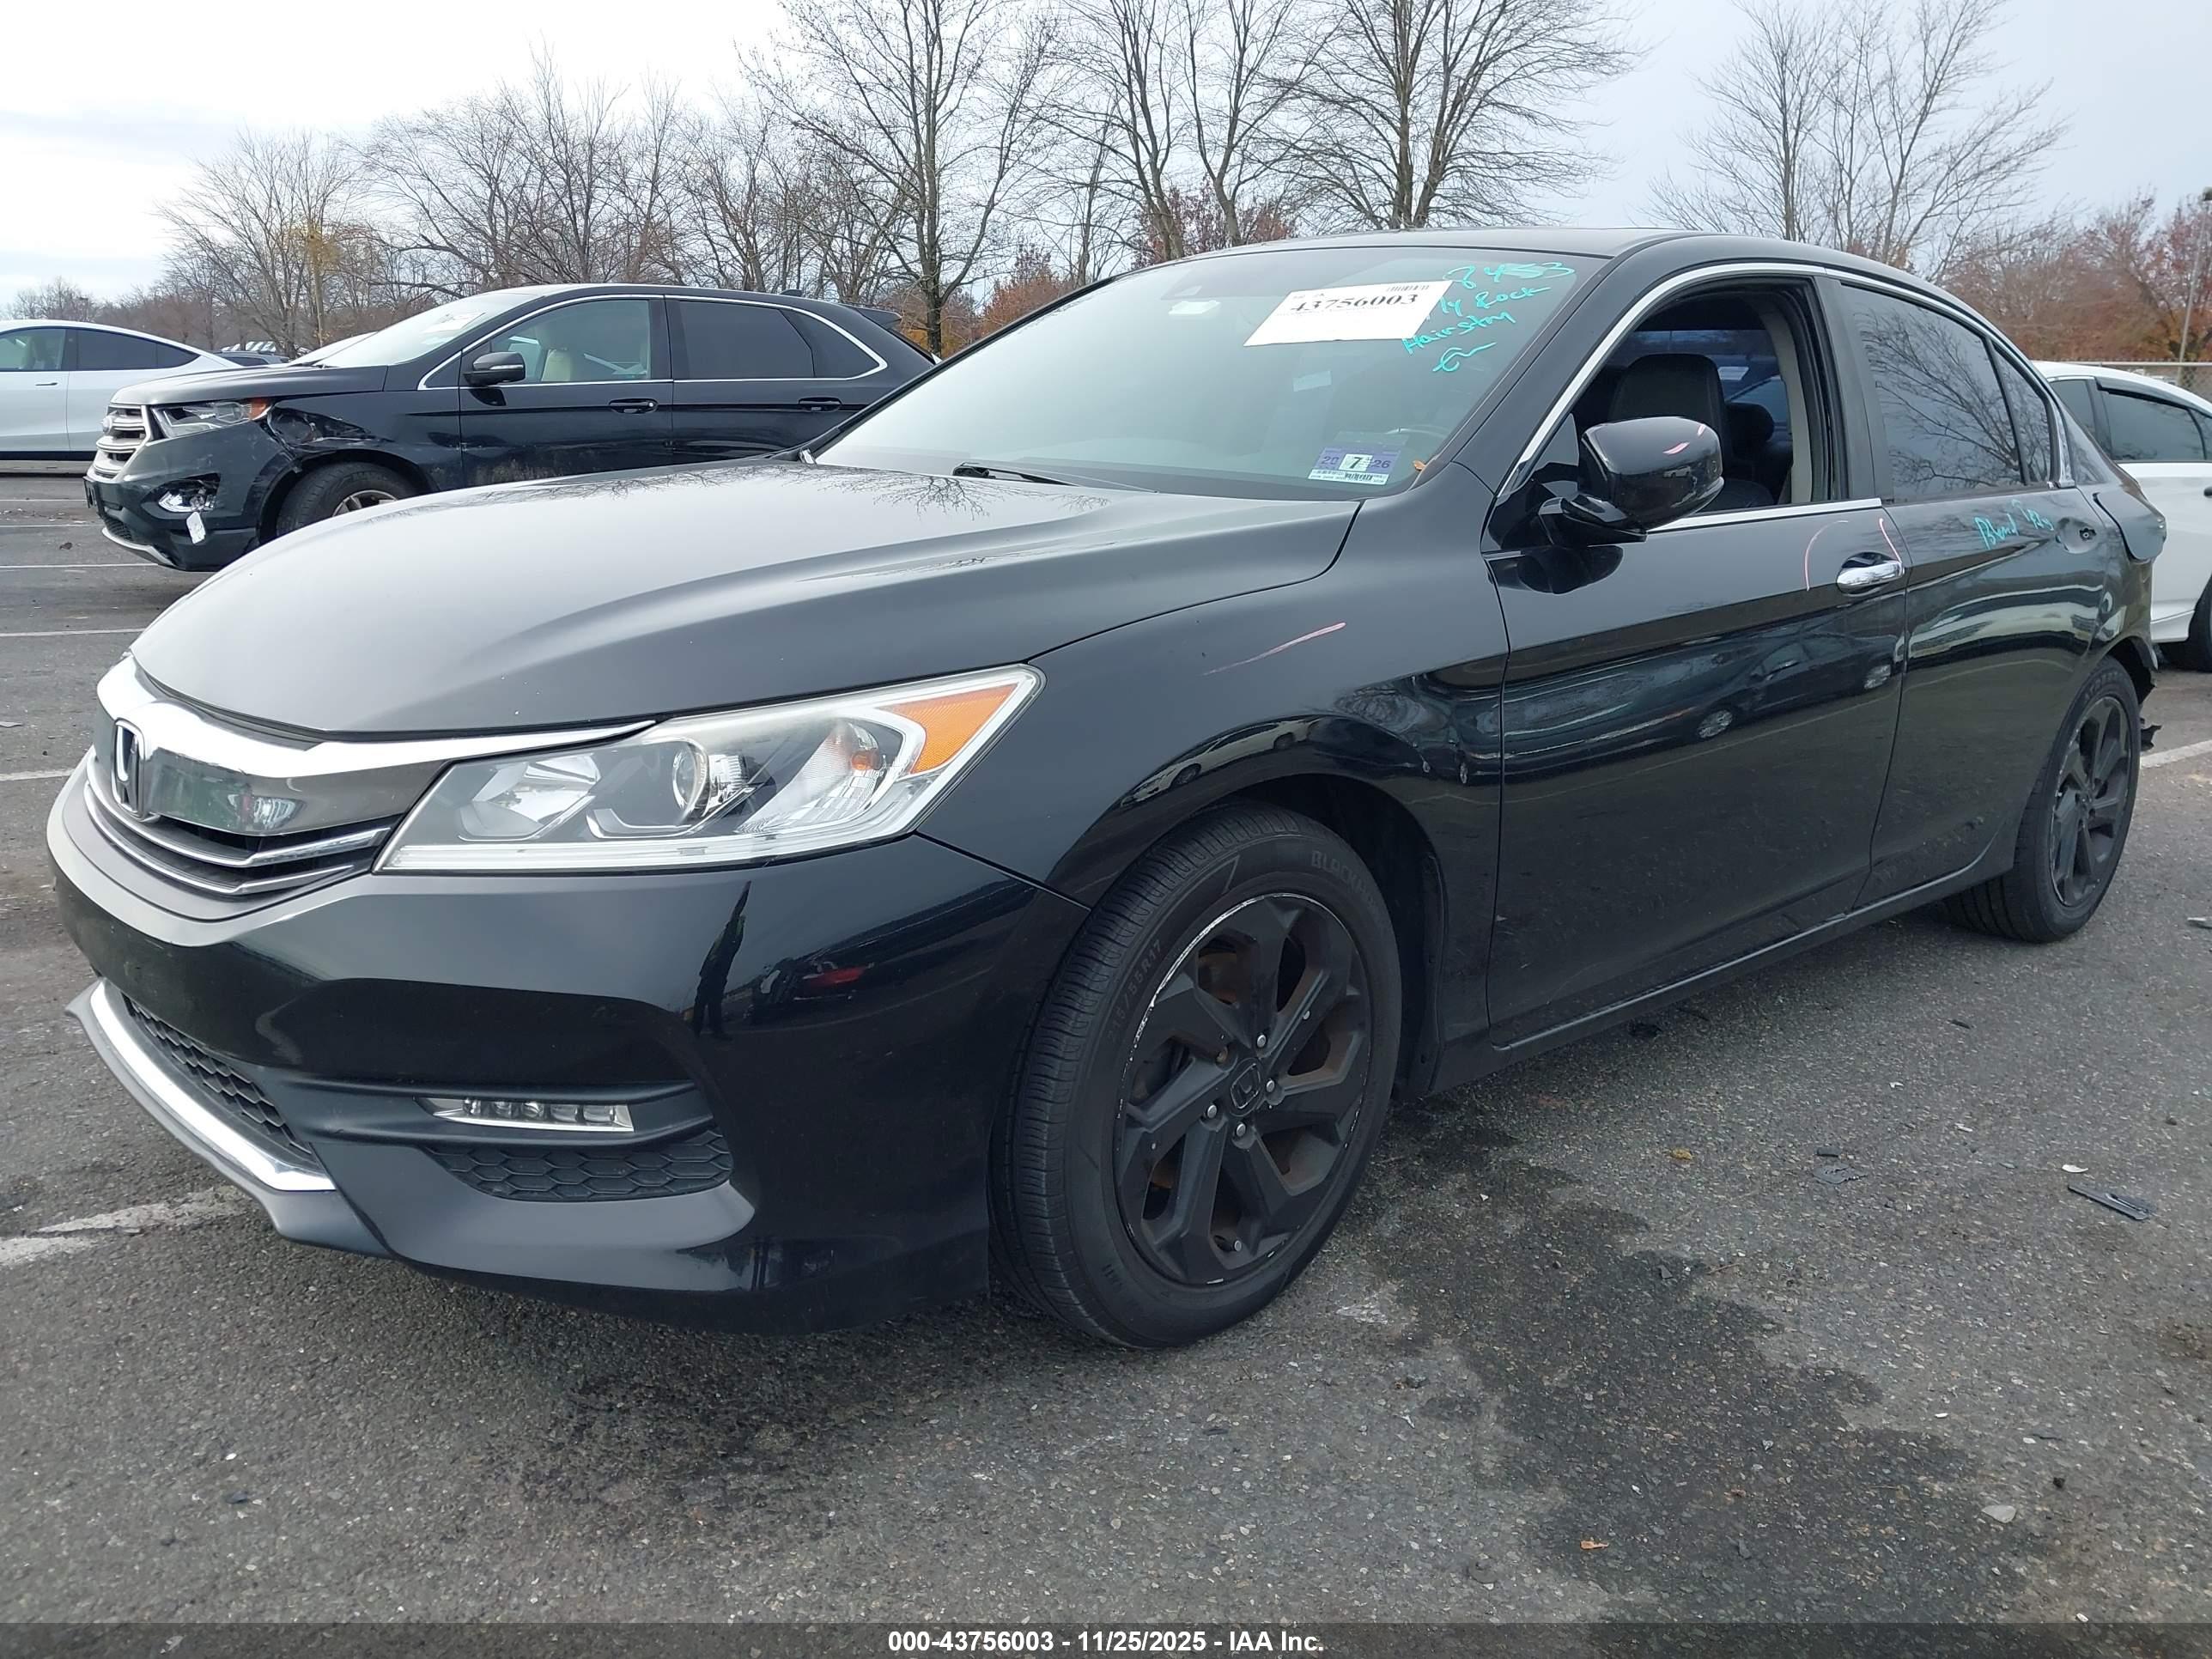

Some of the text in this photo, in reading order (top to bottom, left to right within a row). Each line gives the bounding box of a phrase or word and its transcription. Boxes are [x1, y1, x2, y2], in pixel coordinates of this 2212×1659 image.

[1291, 294, 1419, 312] 43756003
[1322, 455, 1391, 470] 20 7 26
